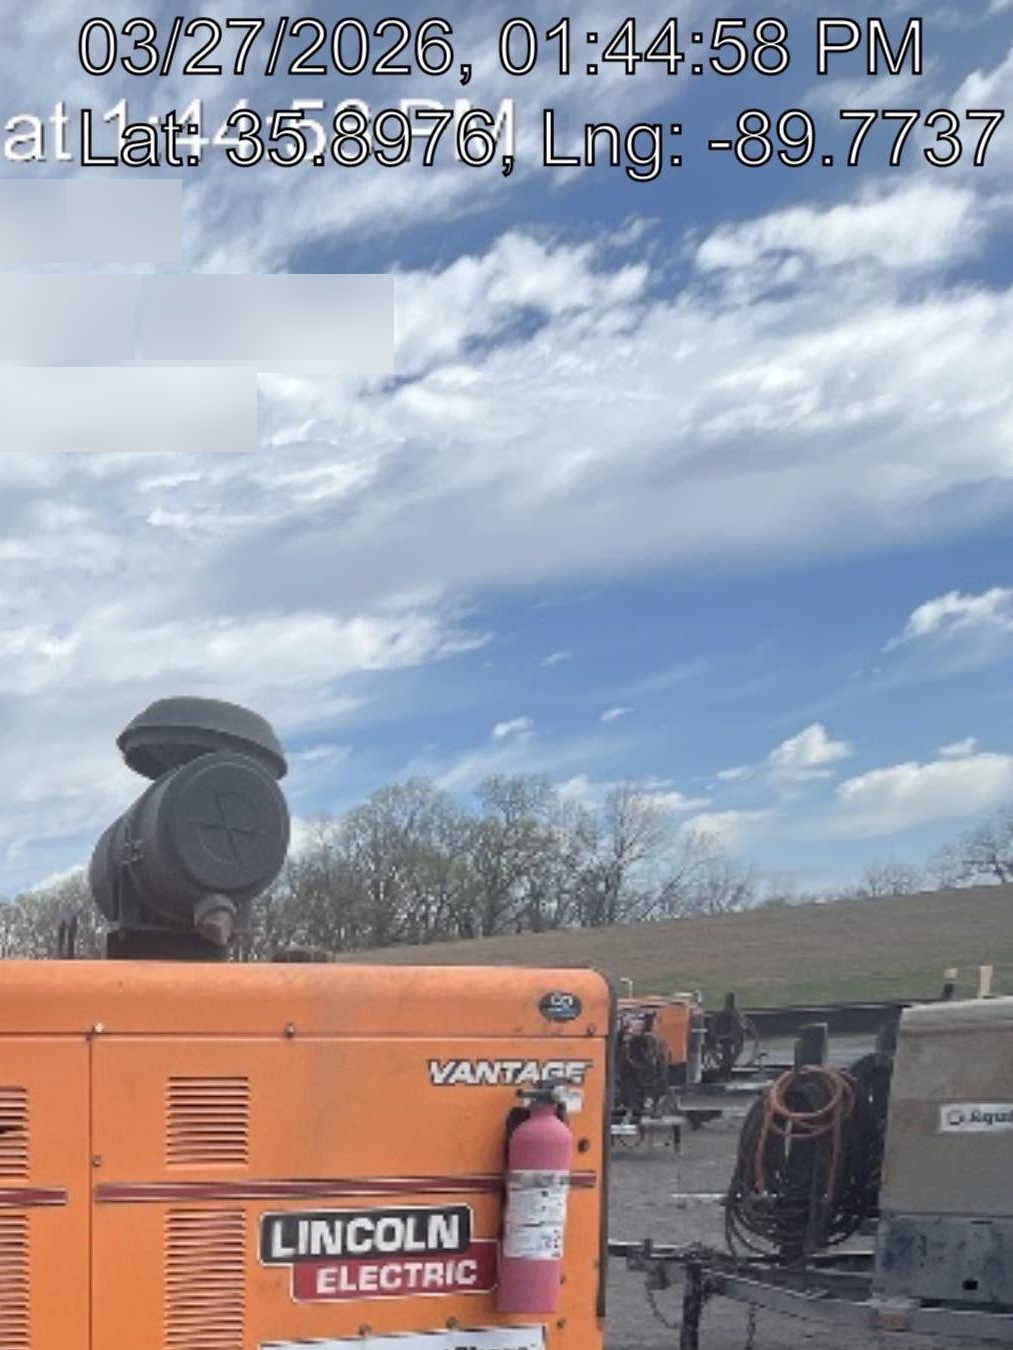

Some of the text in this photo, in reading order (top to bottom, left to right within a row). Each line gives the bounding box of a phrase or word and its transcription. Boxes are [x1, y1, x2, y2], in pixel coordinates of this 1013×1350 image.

[428, 1059, 593, 1086] VANTAGE
[271, 1214, 460, 1258] LINCOLN
[316, 1260, 478, 1295] ELECTRIC
